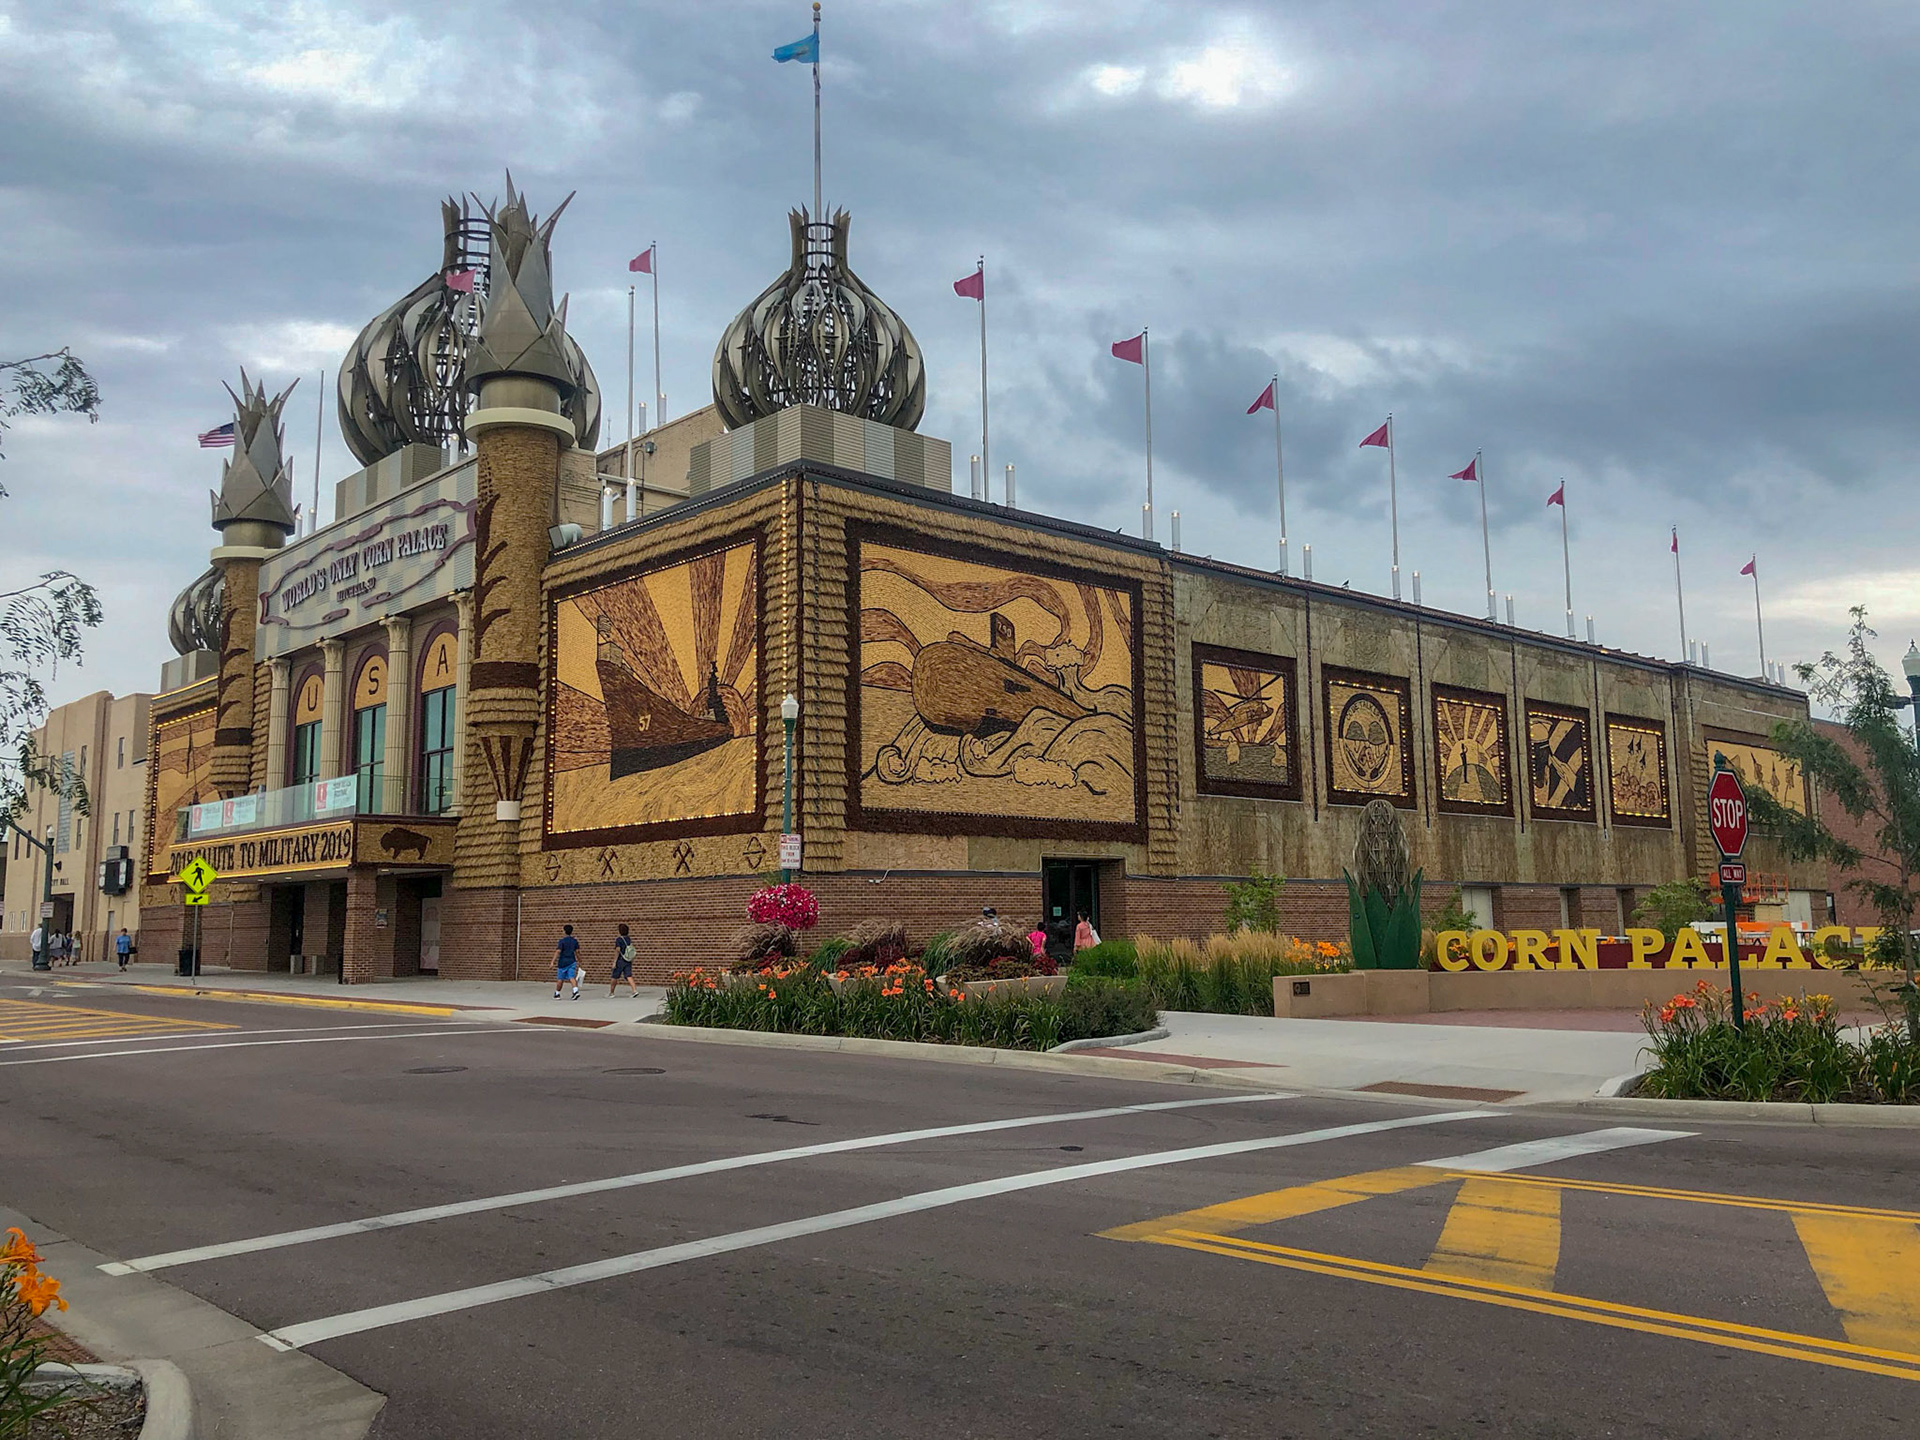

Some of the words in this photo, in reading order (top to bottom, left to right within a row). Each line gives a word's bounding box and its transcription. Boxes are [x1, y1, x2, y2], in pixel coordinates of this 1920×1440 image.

[281, 569, 326, 612] WORLD'S
[329, 552, 359, 585] ONLY
[363, 537, 394, 571] CORN
[396, 524, 448, 558] PALACE
[307, 684, 318, 712] U
[368, 665, 380, 695] S
[436, 643, 449, 677] A
[638, 714, 651, 732] 57
[1713, 797, 1743, 829] STOP
[240, 841, 255, 868] TO
[259, 833, 319, 867] MILITARY
[320, 828, 350, 861] 2019
[1723, 867, 1731, 878] ALL
[1733, 867, 1742, 878] WAY
[1436, 929, 1600, 972] CORN
